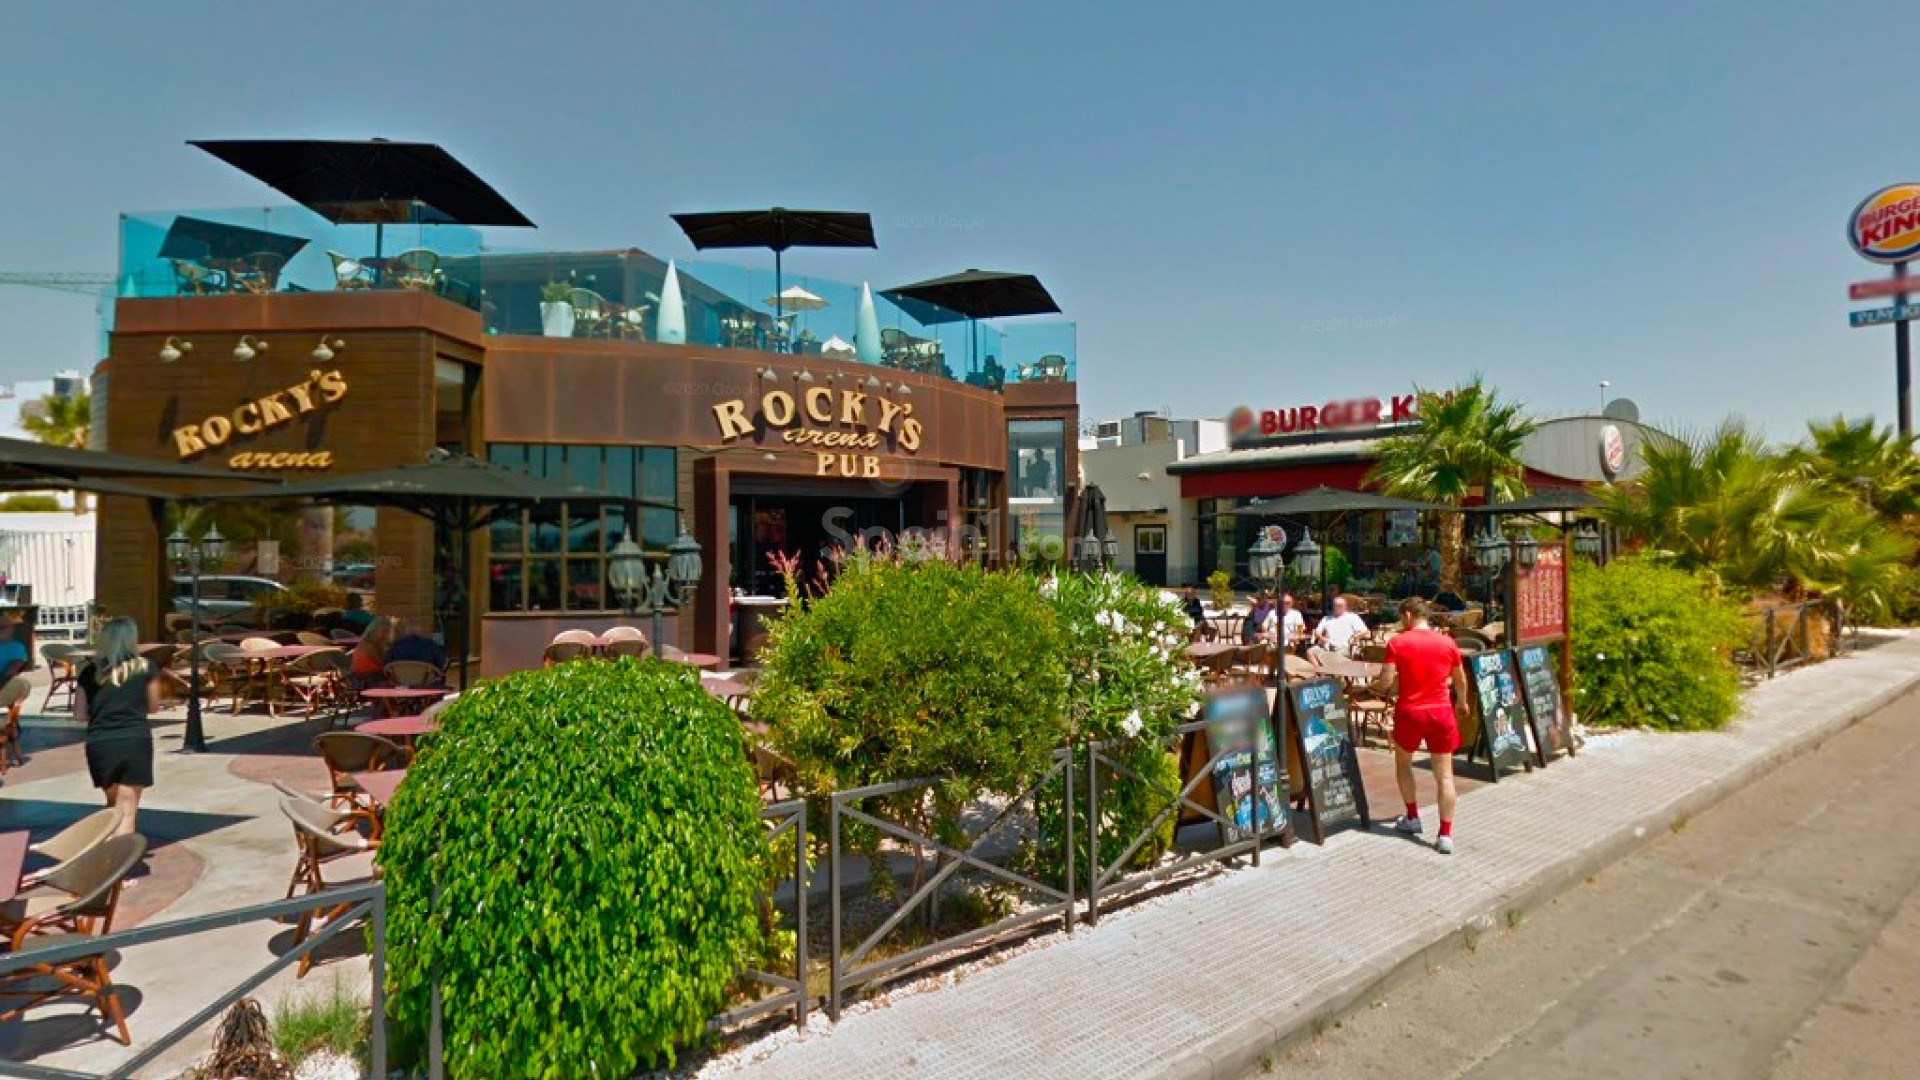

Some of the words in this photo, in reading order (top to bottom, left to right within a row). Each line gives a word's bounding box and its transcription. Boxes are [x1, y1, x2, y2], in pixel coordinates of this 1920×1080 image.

[1862, 211, 1920, 248] KIN
[172, 369, 348, 458] ROCKY'S
[712, 386, 922, 452] ROCKY'S
[1260, 396, 1384, 435] BURGER
[782, 427, 882, 448] arena
[228, 450, 334, 469] arena
[816, 453, 881, 478] PUB
